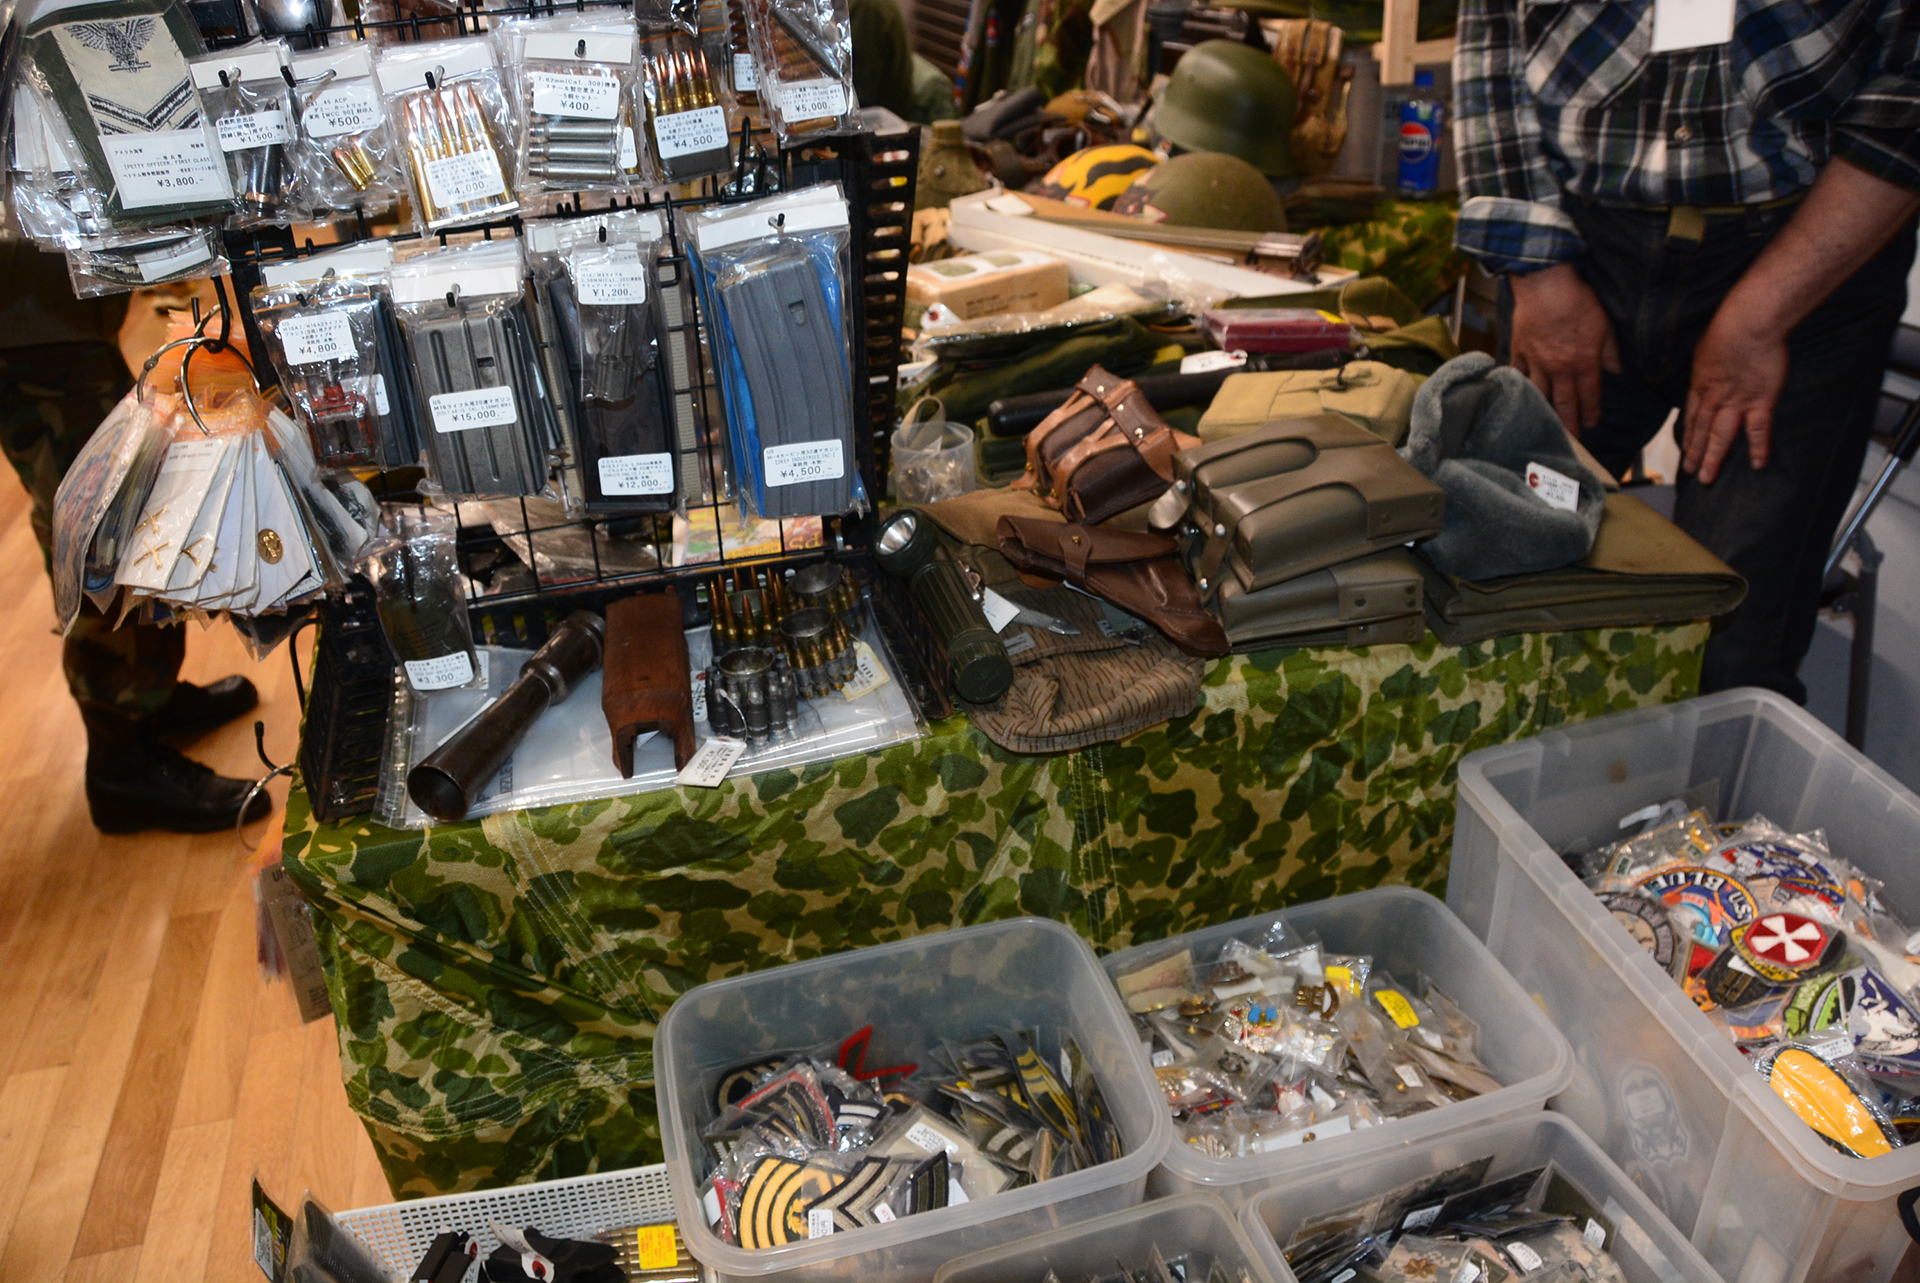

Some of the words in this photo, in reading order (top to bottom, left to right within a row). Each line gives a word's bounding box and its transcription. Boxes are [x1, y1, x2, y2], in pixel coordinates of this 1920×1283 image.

[560, 100, 600, 112] ¥400.-
[795, 101, 836, 113] ¥5,000.-
[328, 115, 372, 128] ¥500.-
[240, 132, 281, 144] ¥1,500.-
[673, 134, 723, 149] ¥4,500.-
[156, 176, 204, 188] ¥3,800.-
[446, 180, 495, 196] ¥4,000.-
[592, 288, 637, 297] ¥1,200.-
[298, 342, 348, 355] ¥4,800.-
[452, 409, 506, 422] ¥15,000.-
[780, 465, 832, 478] ¥4,500.-
[617, 479, 668, 489] ¥12,000.-
[416, 672, 465, 684] ¥3,300.-
